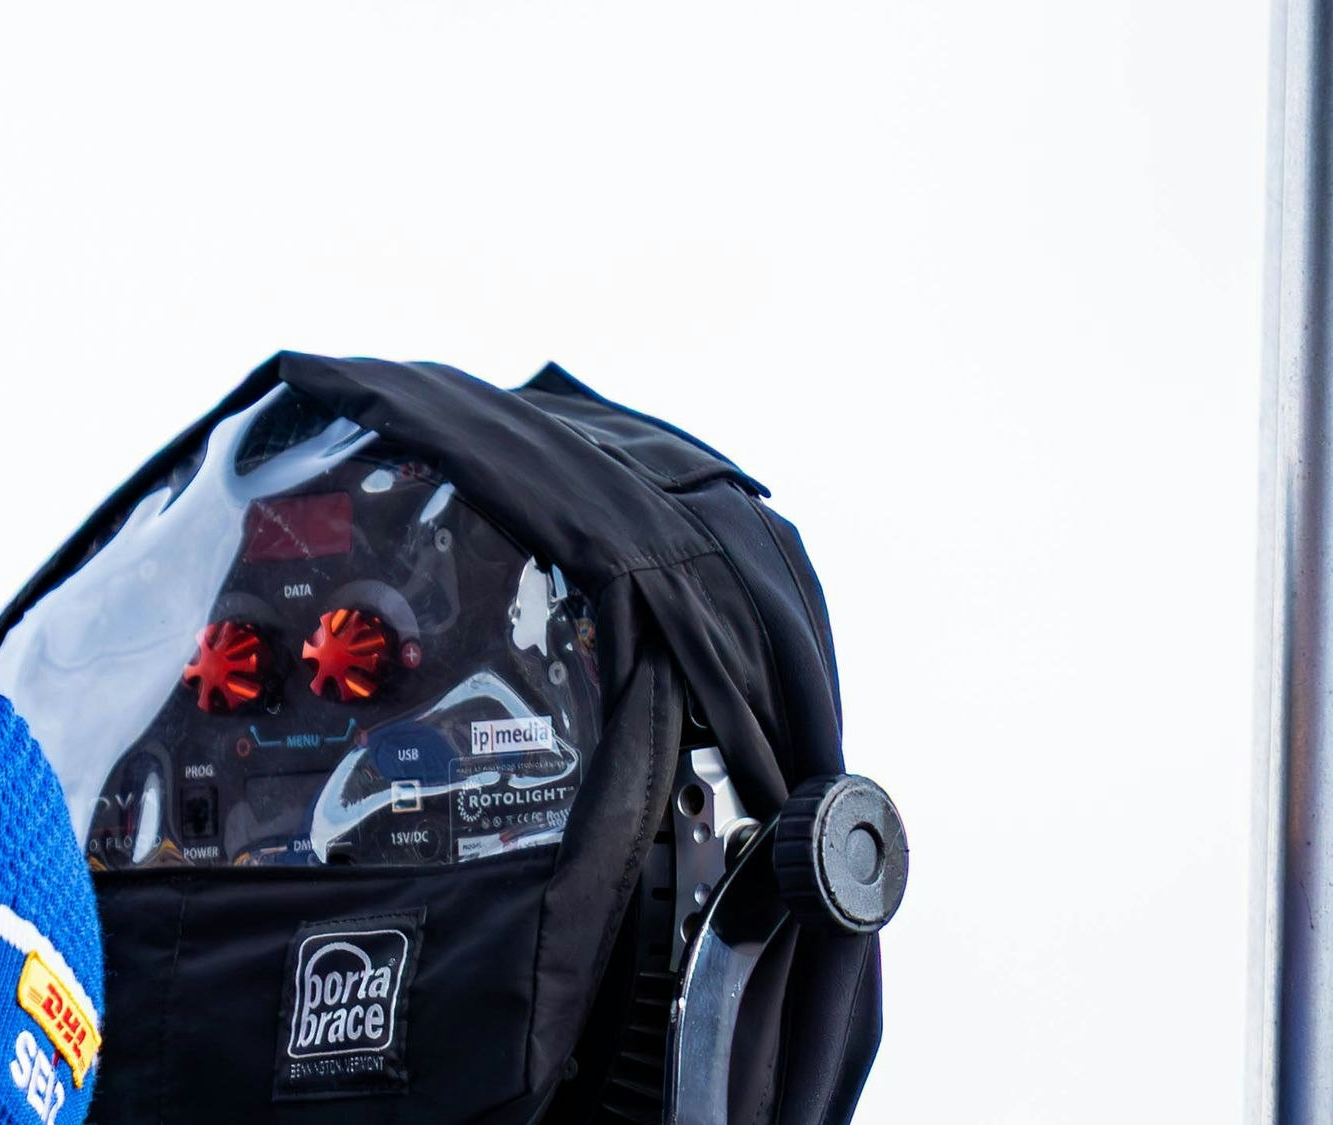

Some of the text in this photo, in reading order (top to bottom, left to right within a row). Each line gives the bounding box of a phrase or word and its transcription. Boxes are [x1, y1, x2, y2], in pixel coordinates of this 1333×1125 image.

[284, 583, 313, 599] DATA
[286, 734, 319, 747] MENU
[397, 748, 419, 761] USB
[185, 764, 214, 778] PROG
[293, 839, 313, 852] DM
[183, 846, 219, 860] POWER
[41, 982, 86, 1058] DHL
[297, 1003, 384, 1048] brace
